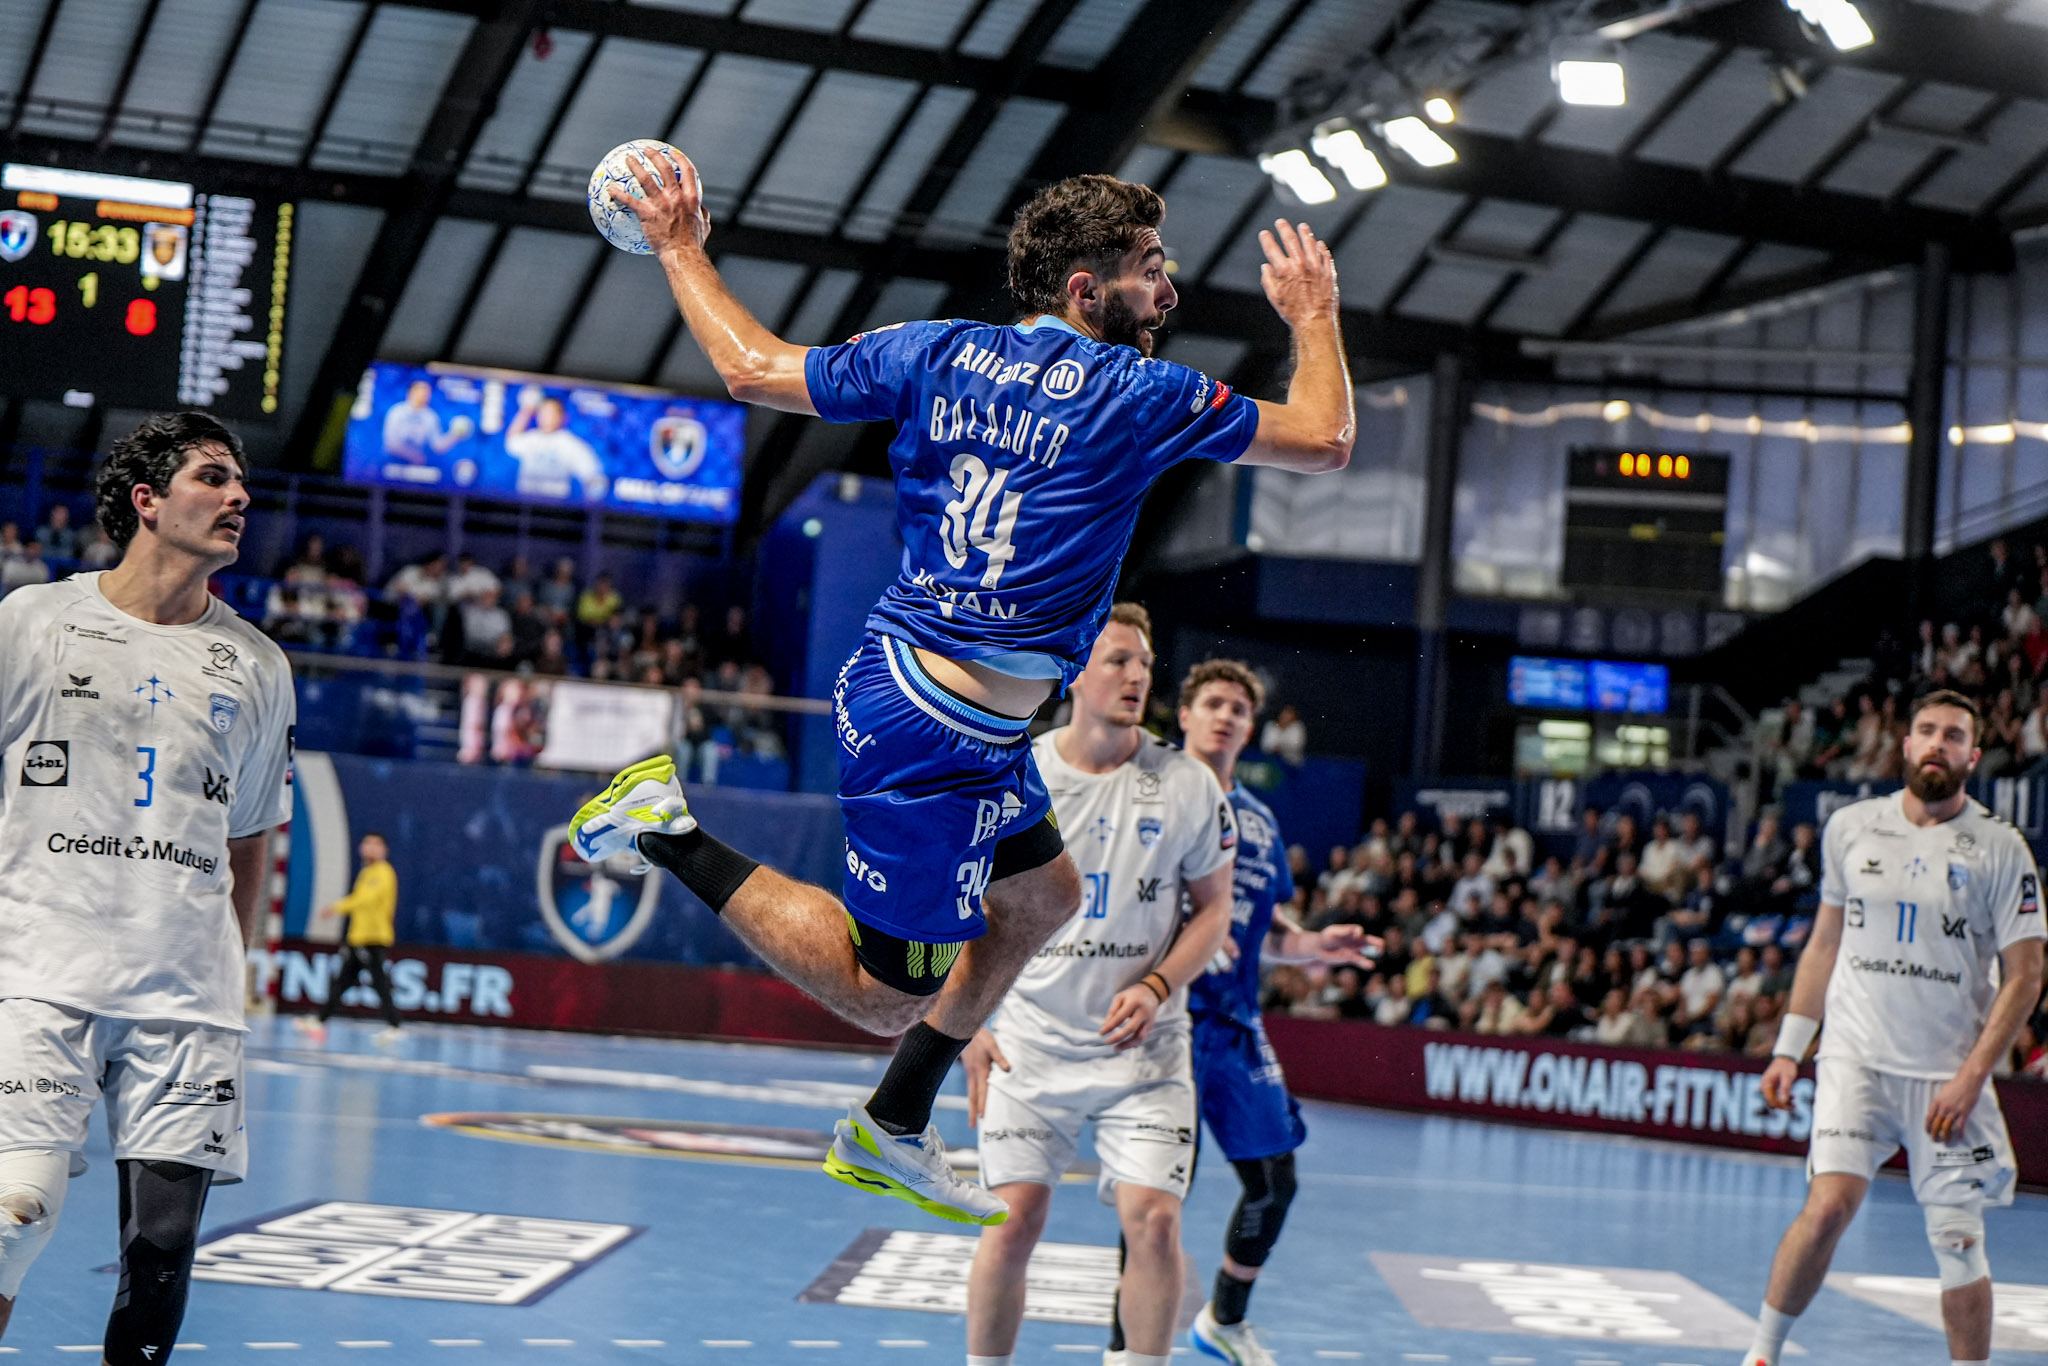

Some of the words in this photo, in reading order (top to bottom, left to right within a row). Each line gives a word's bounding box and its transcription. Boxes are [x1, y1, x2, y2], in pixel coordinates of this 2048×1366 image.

[4, 285, 57, 325] 13
[77, 272, 99, 309] 1
[951, 342, 1041, 387] Allianz
[930, 395, 1070, 470] BALAGUER
[939, 453, 1023, 590] 34
[61, 687, 100, 700] erima
[133, 746, 156, 807] 3
[48, 832, 122, 857] Crédit
[152, 840, 218, 876] Mutuel
[956, 856, 993, 920] 34
[1896, 902, 1917, 944] 11
[1909, 963, 1961, 984] Mutuel
